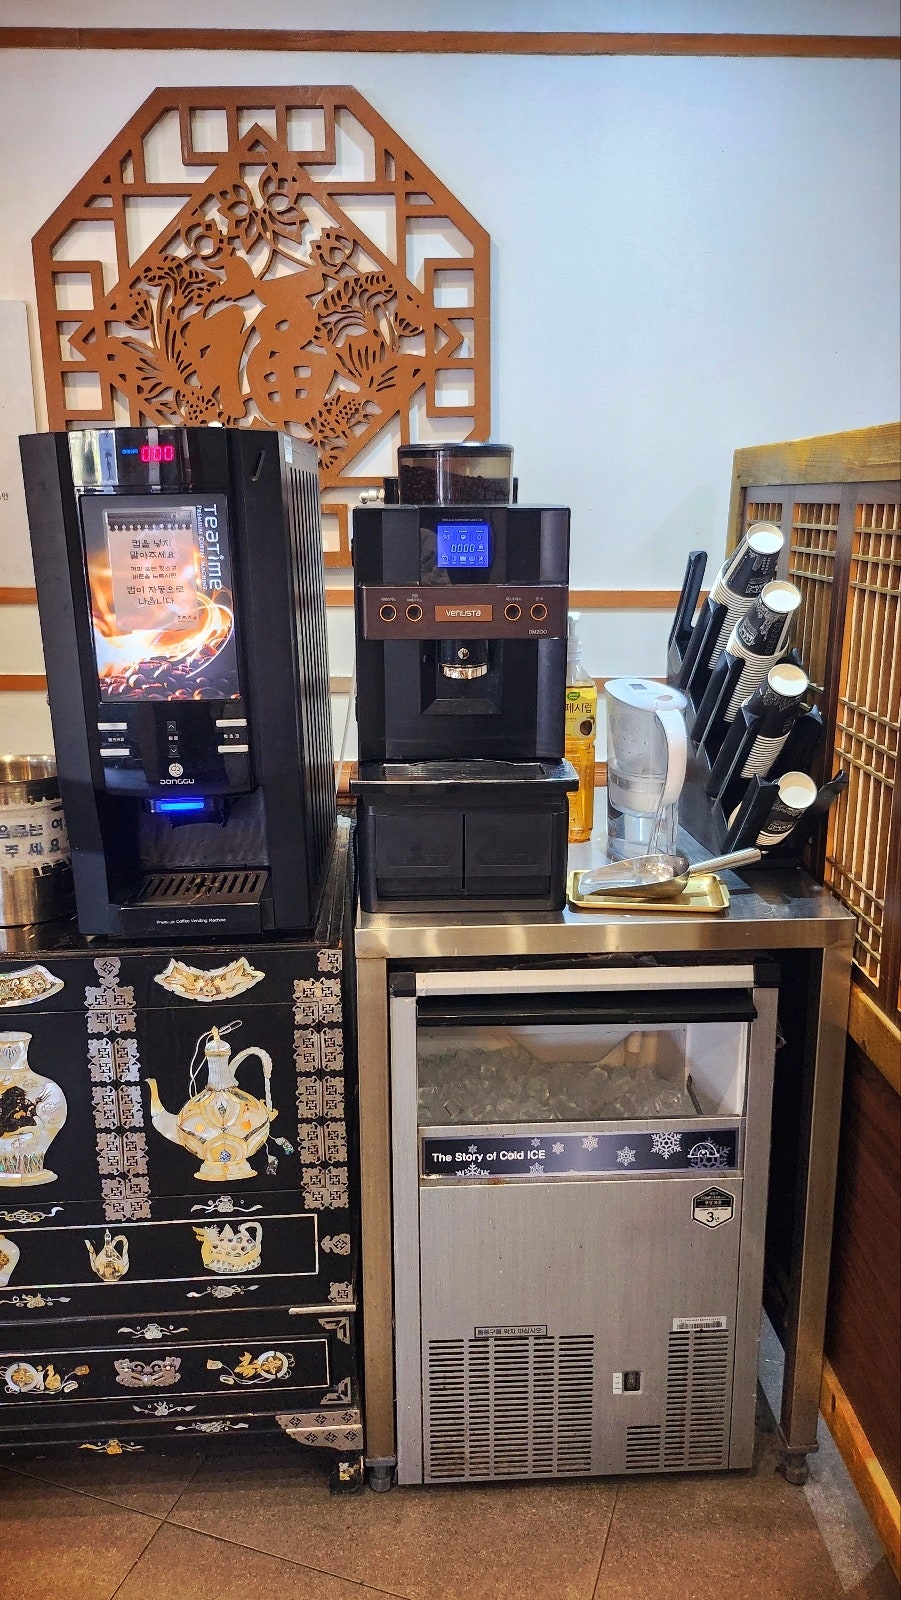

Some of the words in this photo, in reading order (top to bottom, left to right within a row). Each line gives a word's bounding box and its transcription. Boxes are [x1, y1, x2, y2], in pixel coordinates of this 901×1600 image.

[131, 539, 150, 548] 컵을
[148, 585, 184, 594] 자동으로
[138, 596, 174, 605] 나옵니다
[565, 702, 592, 713] 페시럽
[432, 1152, 453, 1162] The
[455, 1152, 484, 1162] Story
[486, 1151, 497, 1160] of
[499, 1149, 525, 1160] Cold
[527, 1149, 546, 1159] ICE
